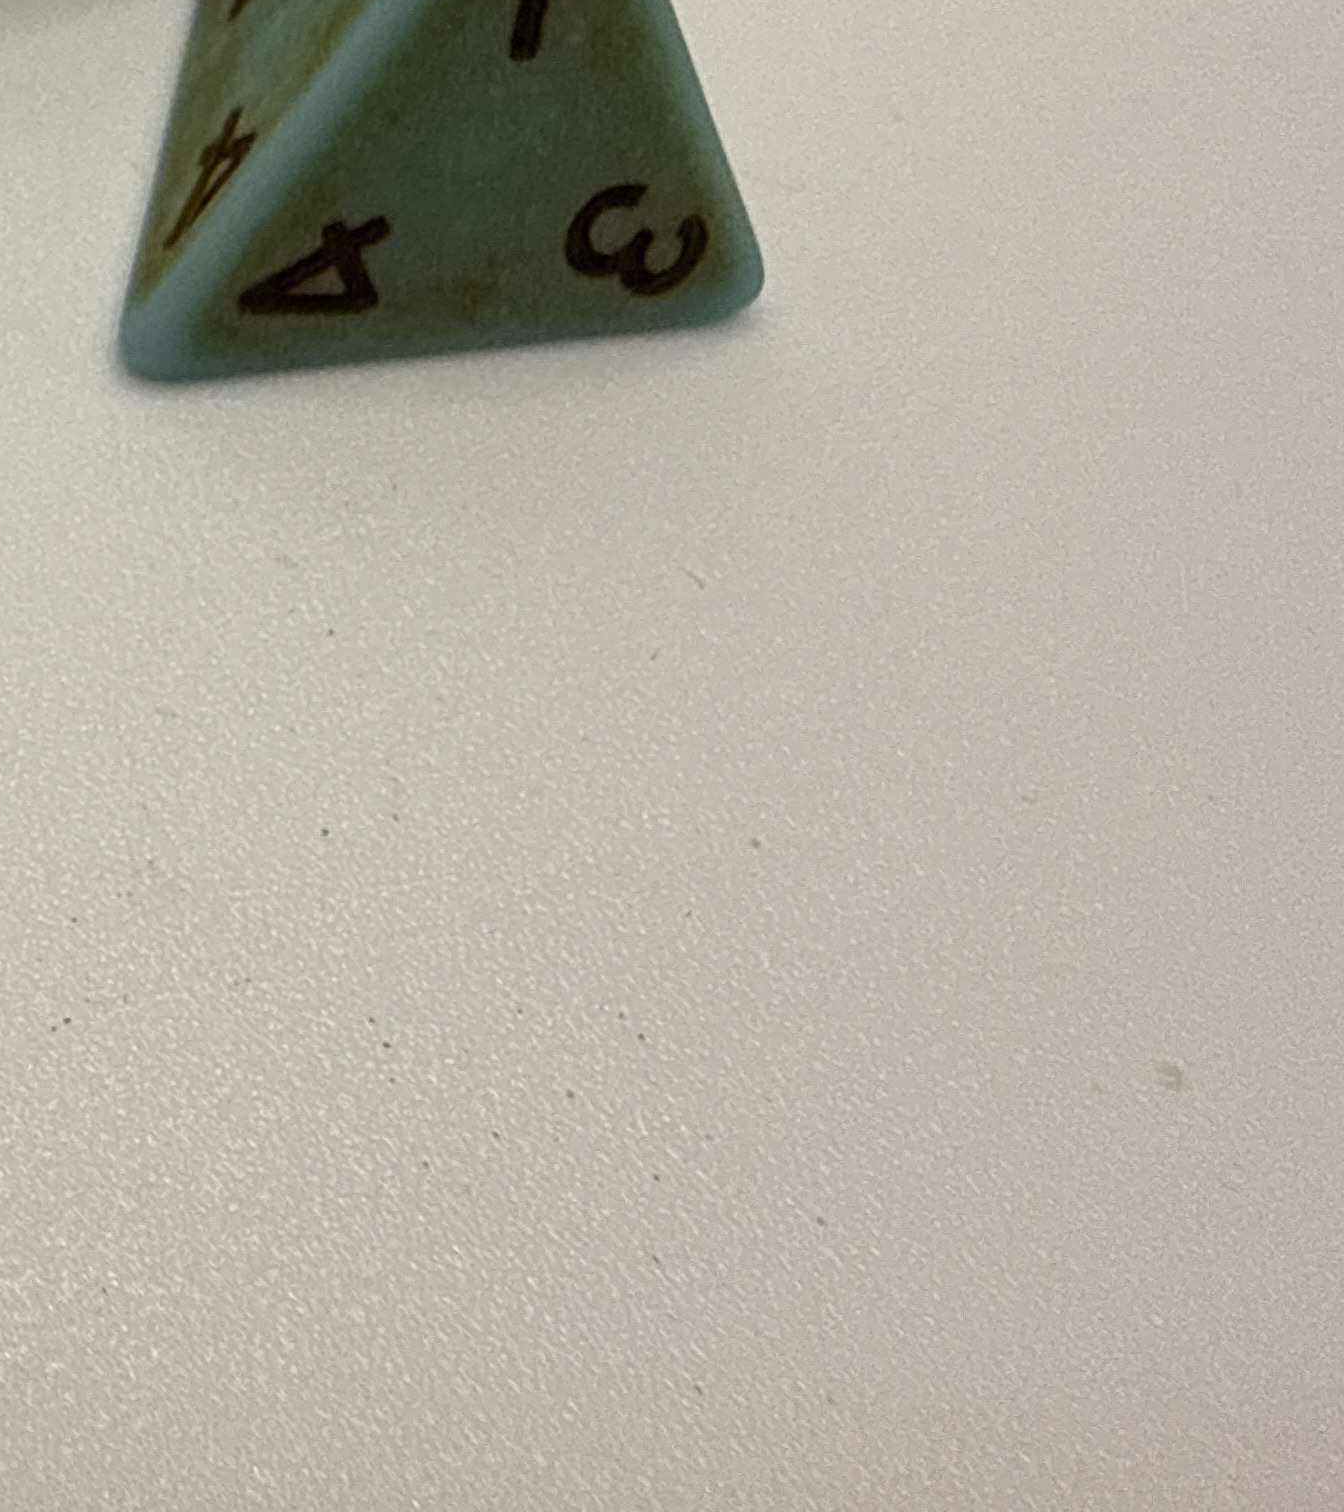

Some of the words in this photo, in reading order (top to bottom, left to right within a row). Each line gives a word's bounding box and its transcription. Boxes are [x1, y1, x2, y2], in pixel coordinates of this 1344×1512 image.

[162, 106, 257, 253] 4
[237, 213, 392, 317] 4
[564, 181, 710, 299] 3
